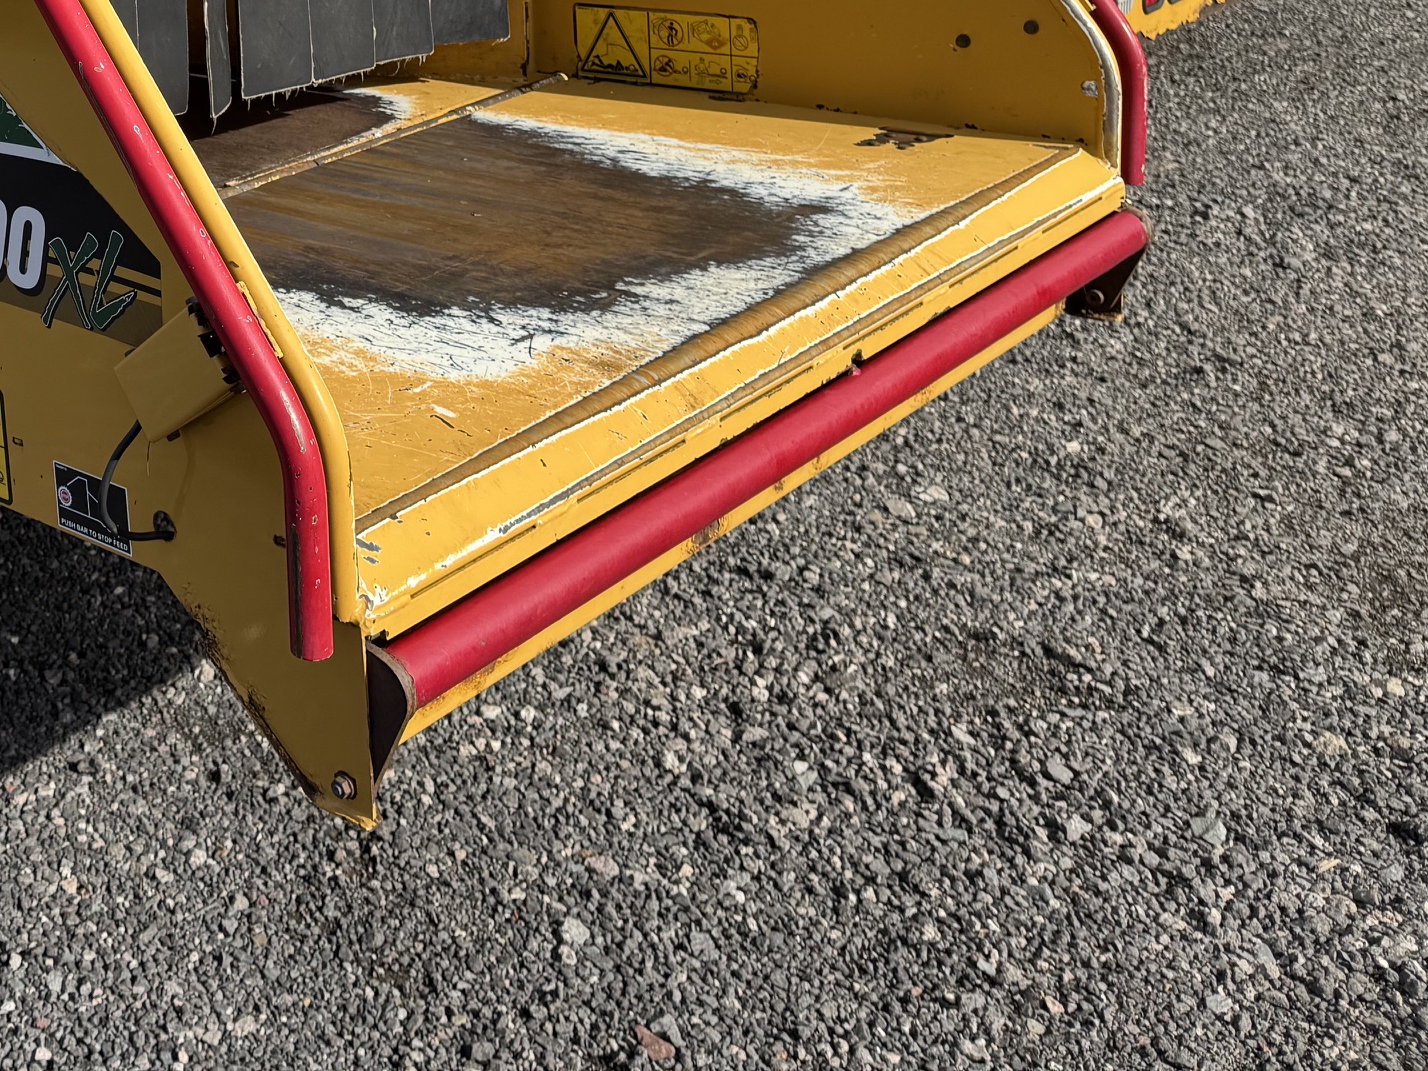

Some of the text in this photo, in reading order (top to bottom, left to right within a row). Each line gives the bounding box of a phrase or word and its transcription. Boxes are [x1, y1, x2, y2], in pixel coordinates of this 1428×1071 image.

[61, 517, 128, 551] PUSH BAR TO STOP FEED
